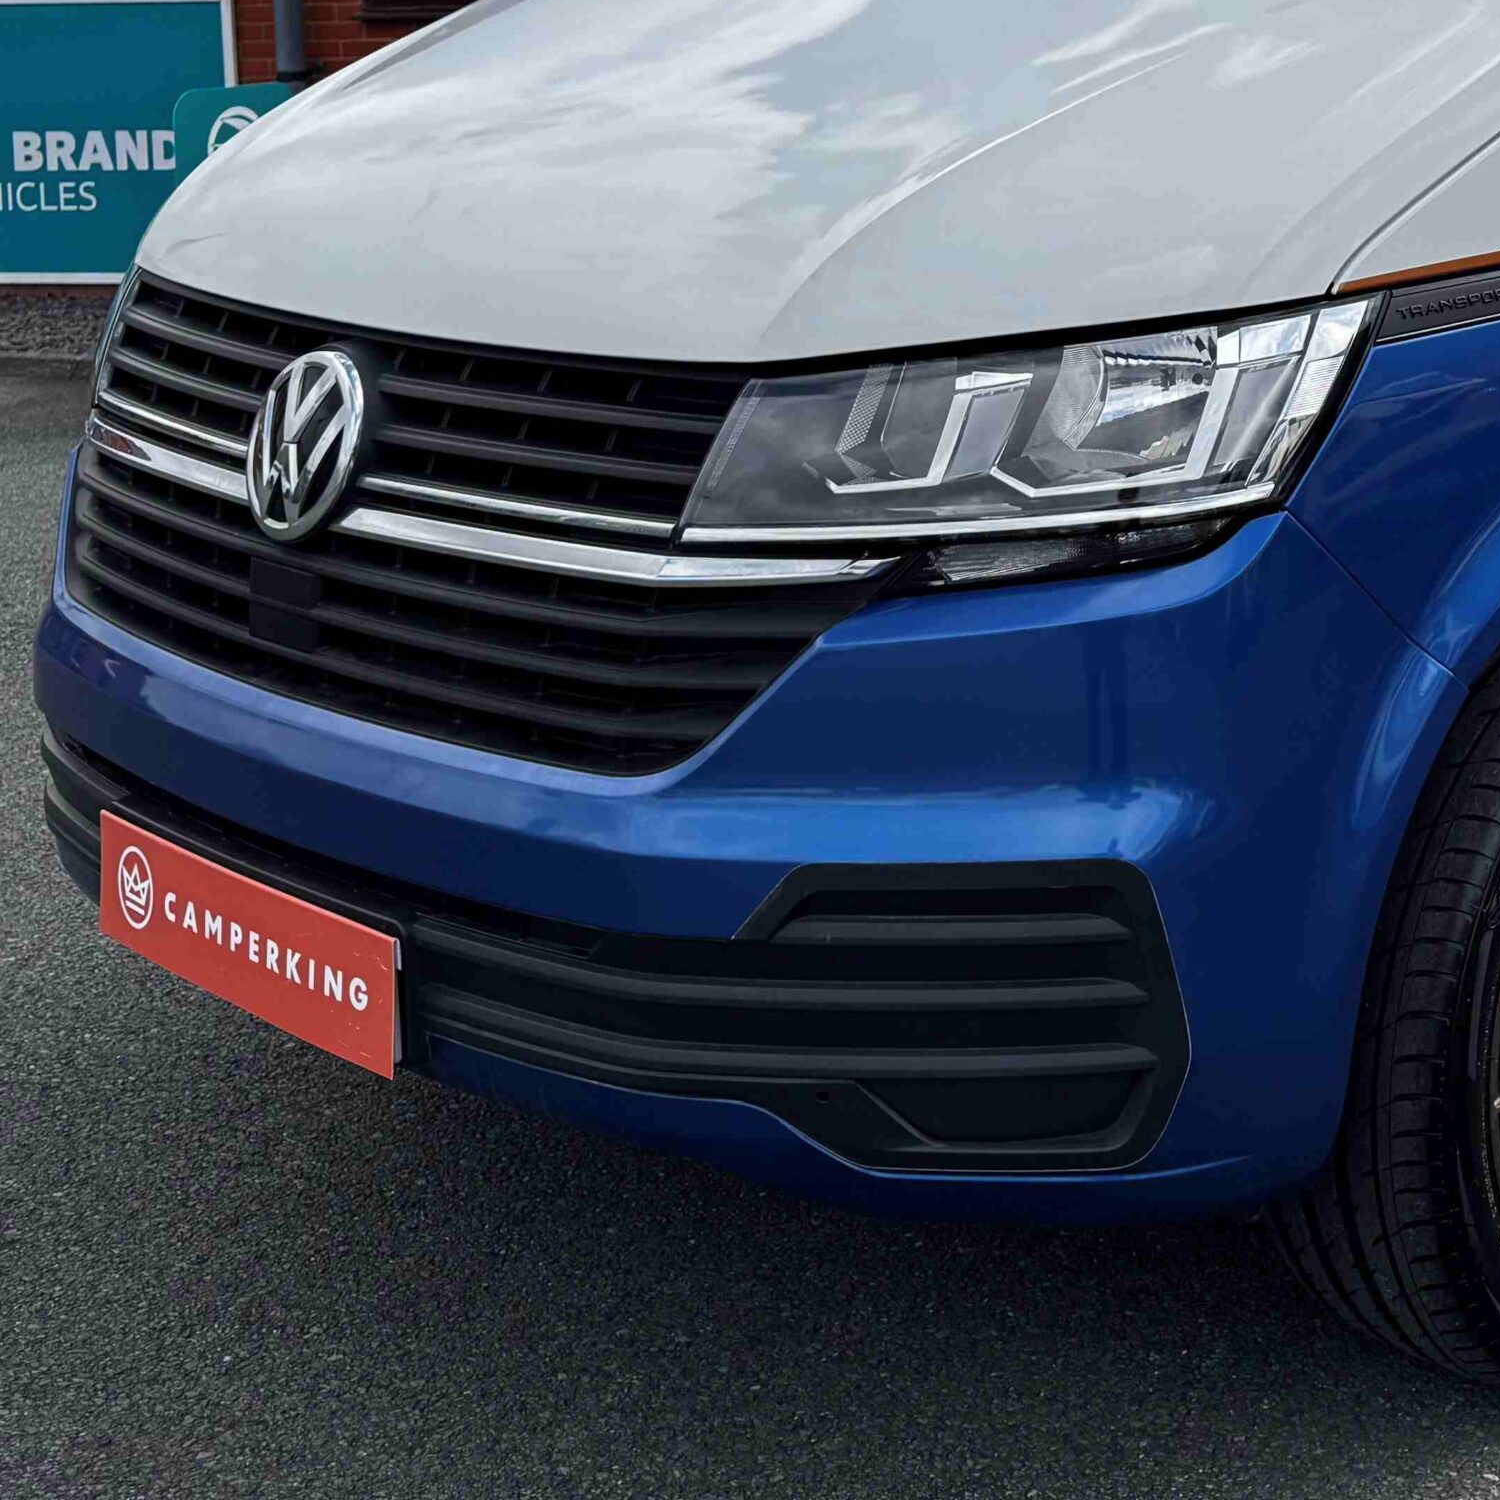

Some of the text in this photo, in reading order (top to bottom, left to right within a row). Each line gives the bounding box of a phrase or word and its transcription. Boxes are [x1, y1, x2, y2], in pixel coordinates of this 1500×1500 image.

[12, 130, 177, 172] BRAND
[0, 181, 98, 212] ICLES
[163, 892, 369, 1012] CAMPERKING
